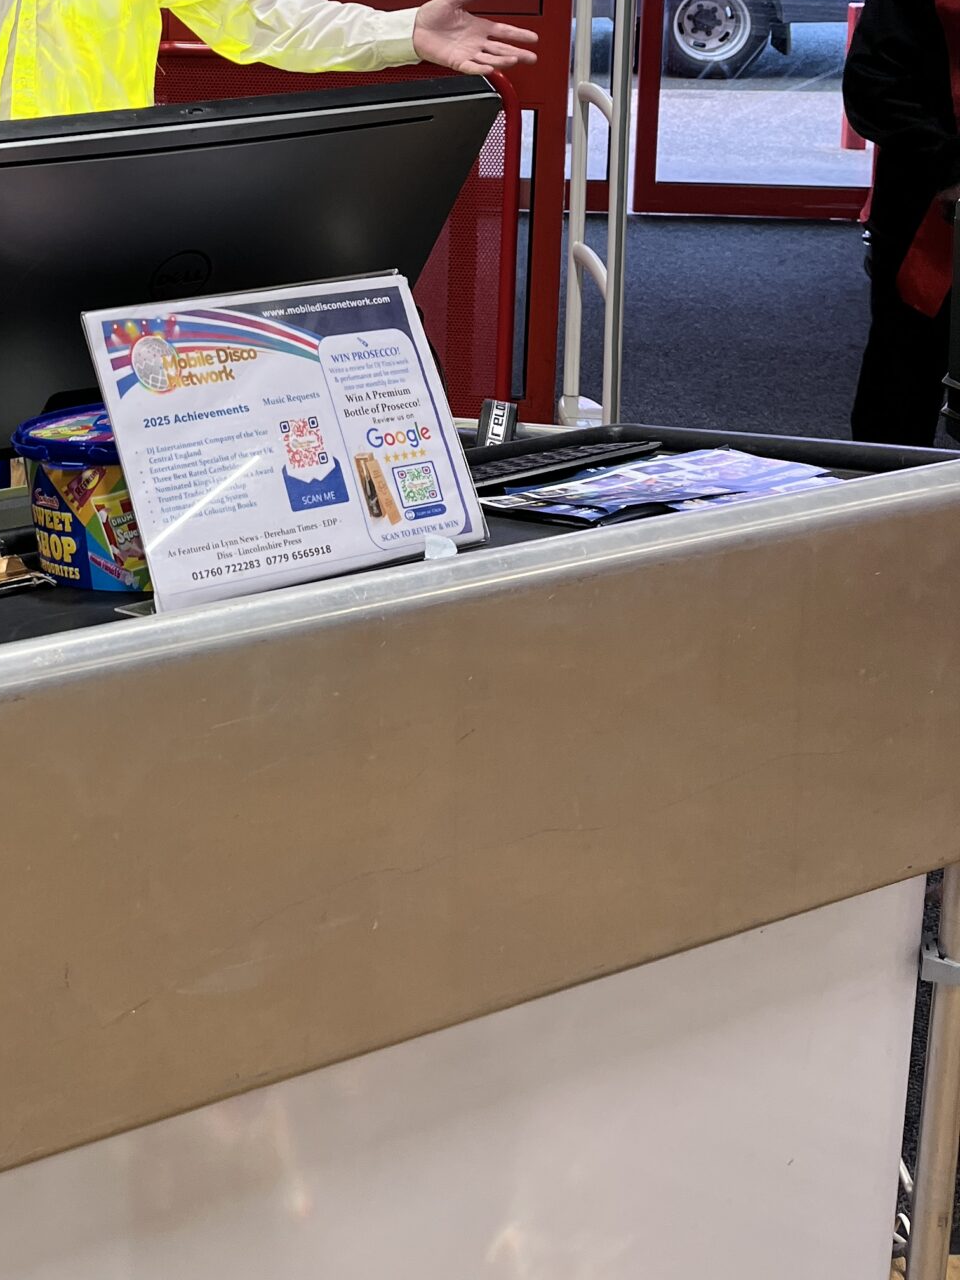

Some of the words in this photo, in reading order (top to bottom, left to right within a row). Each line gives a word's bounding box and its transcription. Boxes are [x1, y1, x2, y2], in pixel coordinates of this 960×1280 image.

[262, 296, 390, 318] www.mobiledisconetwork.com
[162, 351, 214, 372] Mobile
[215, 346, 257, 364] Disco
[331, 352, 350, 364] WIN
[352, 346, 400, 361] PROSECCO!
[166, 365, 235, 389] Network
[262, 395, 286, 406] Music
[287, 391, 320, 404] Requests
[345, 392, 364, 404] Win
[365, 391, 372, 401] A
[373, 387, 411, 400] Premium
[143, 415, 171, 429] 2025
[174, 404, 250, 424] Achievements
[343, 405, 369, 418] Bottle
[371, 404, 380, 414] of
[381, 398, 421, 413] Prosecco!
[372, 416, 395, 424] Review
[366, 421, 431, 448] Google
[146, 447, 155, 456] DJ
[156, 440, 203, 453] Entertainment
[204, 435, 235, 446] Company
[149, 455, 174, 465] Central
[175, 449, 202, 461] England
[149, 461, 198, 475] Entertainment
[302, 494, 323, 505] SCAN
[323, 491, 336, 501] ME
[167, 549, 176, 558] As
[178, 544, 211, 556] Featured
[221, 538, 239, 548] Lynn
[240, 534, 259, 545] News
[264, 528, 296, 539] Dereham
[297, 522, 318, 532] Times
[322, 517, 338, 527] EDP
[381, 531, 400, 542] SCAN
[401, 529, 411, 538] TO
[412, 524, 437, 535] REVIEW
[444, 519, 459, 529] WIN
[217, 551, 233, 560] Diss
[238, 541, 282, 557] Lincolnshire
[283, 537, 302, 547] Press
[191, 566, 223, 581] 01760
[225, 559, 261, 574] 722283
[265, 553, 289, 566] 0779
[292, 544, 332, 561] 6565918
